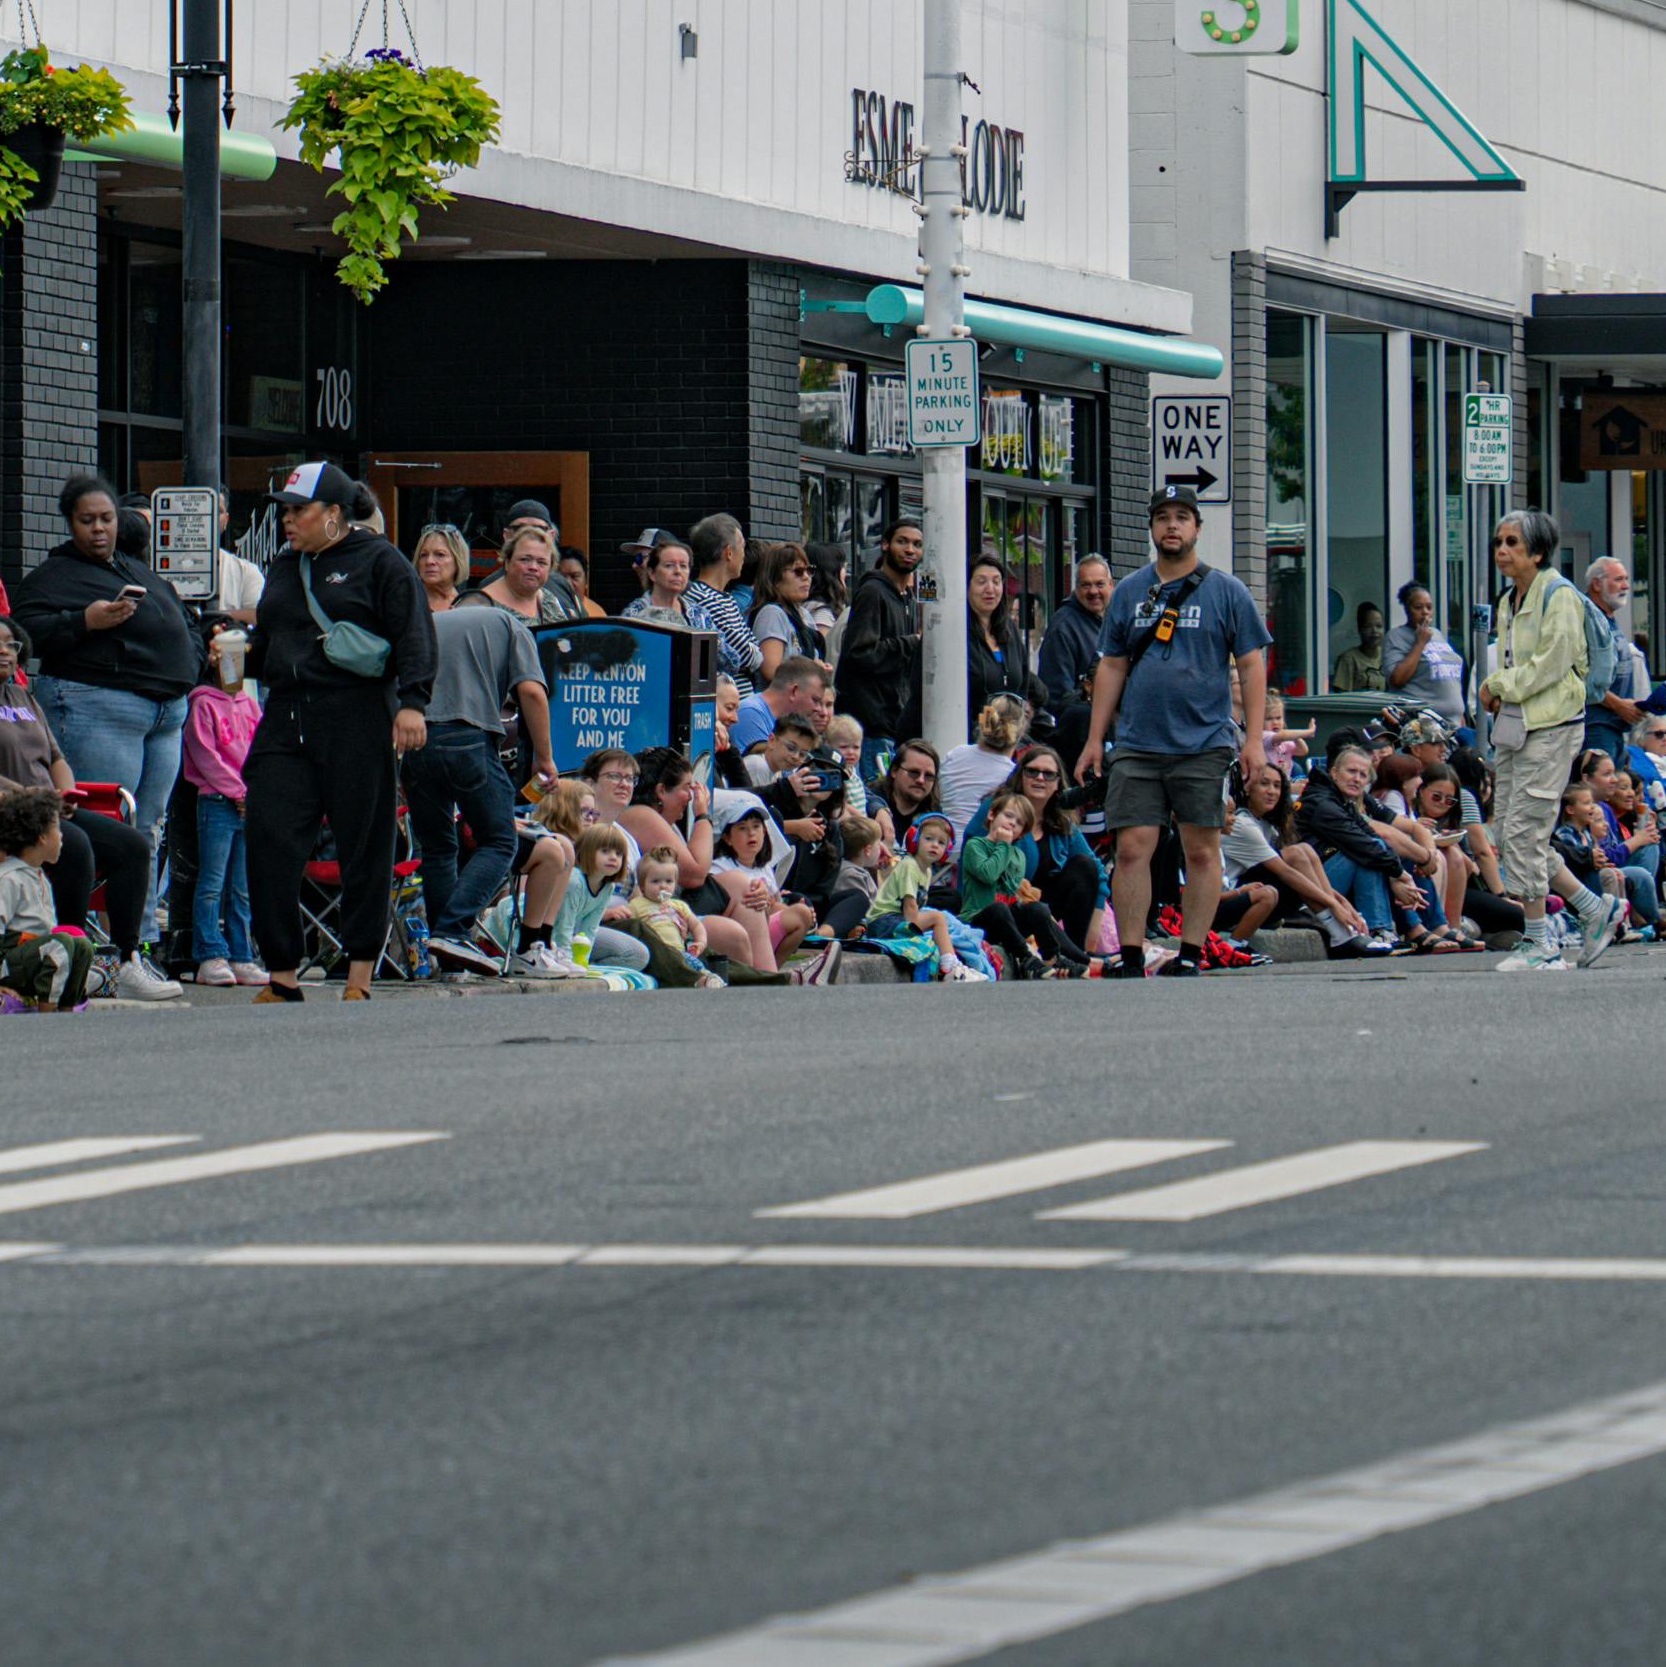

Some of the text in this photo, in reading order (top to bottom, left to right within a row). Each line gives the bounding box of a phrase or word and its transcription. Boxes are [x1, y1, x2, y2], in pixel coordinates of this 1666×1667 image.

[853, 88, 1025, 221] ESME LODIE
[930, 352, 953, 373] 15
[917, 376, 967, 391] MINUTE
[317, 366, 352, 430] 708
[915, 394, 971, 409] PARKING
[1163, 405, 1221, 429] ONE
[1468, 400, 1501, 425] 2 HR
[1480, 414, 1509, 425] PARKING
[924, 419, 964, 433] ONLY
[1162, 435, 1223, 460] WAY
[564, 685, 640, 705] LITTER FREE
[572, 707, 631, 726] FOR YOU
[694, 712, 712, 731] TRASH
[576, 730, 625, 749] AND ME
